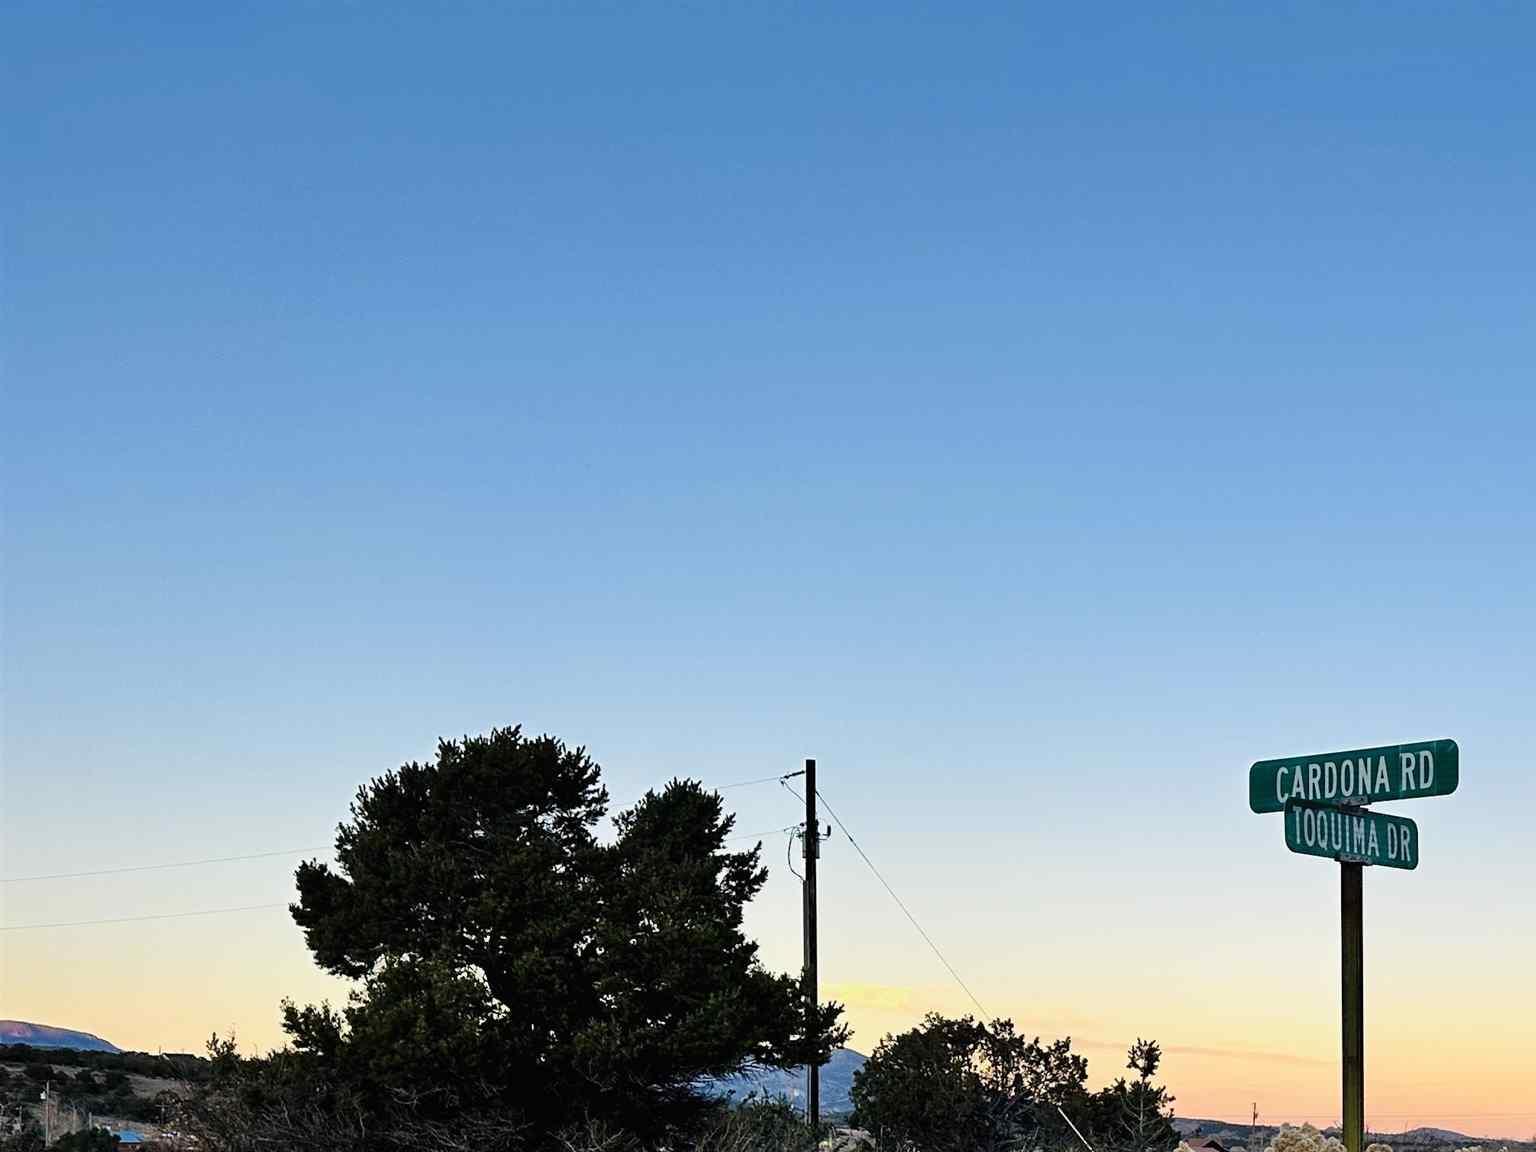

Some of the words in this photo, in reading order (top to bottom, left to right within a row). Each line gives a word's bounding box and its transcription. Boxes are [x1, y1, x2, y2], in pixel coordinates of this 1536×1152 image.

[1276, 756, 1390, 803] CARDONA
[1399, 750, 1434, 791] RD
[1293, 806, 1380, 857] TOQUIMA
[1387, 822, 1412, 861] DR
